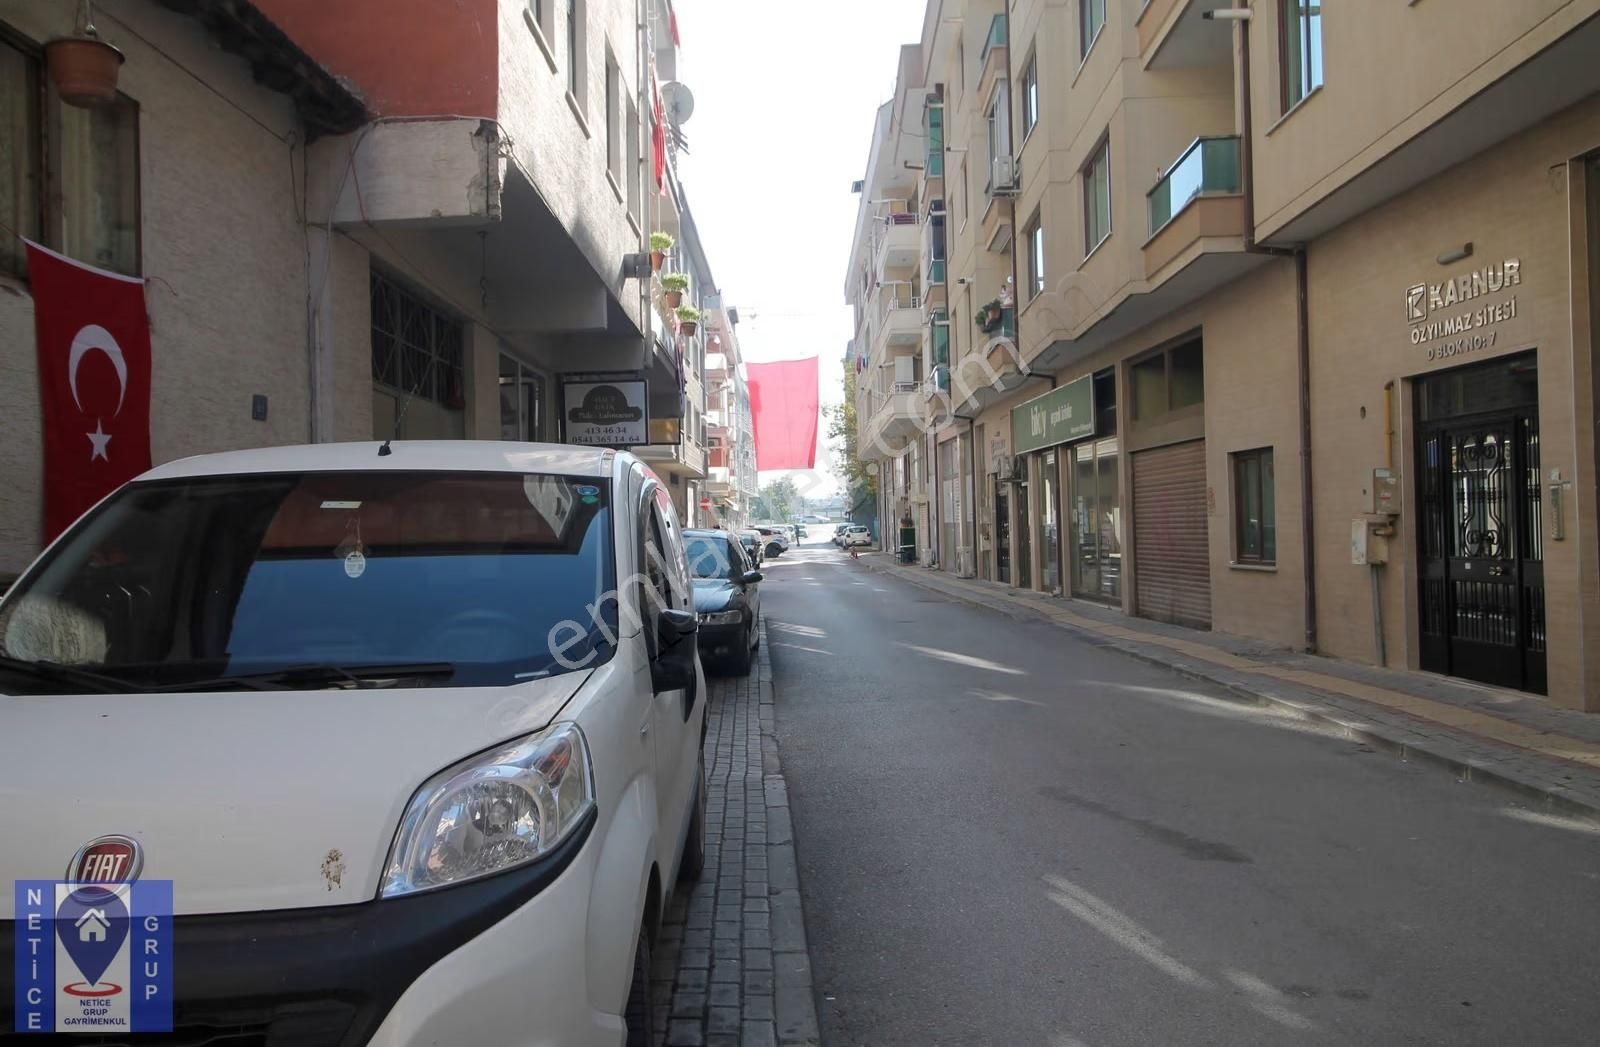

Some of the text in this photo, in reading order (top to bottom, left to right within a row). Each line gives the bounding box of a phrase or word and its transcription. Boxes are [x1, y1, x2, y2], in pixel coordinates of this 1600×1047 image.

[1430, 258, 1521, 311] KARNUR
[1476, 296, 1517, 327] SİTESİ
[1438, 339, 1463, 360] BLOK
[1490, 331, 1497, 346] 7
[616, 426, 626, 434] 34
[80, 853, 128, 883] FIAT
